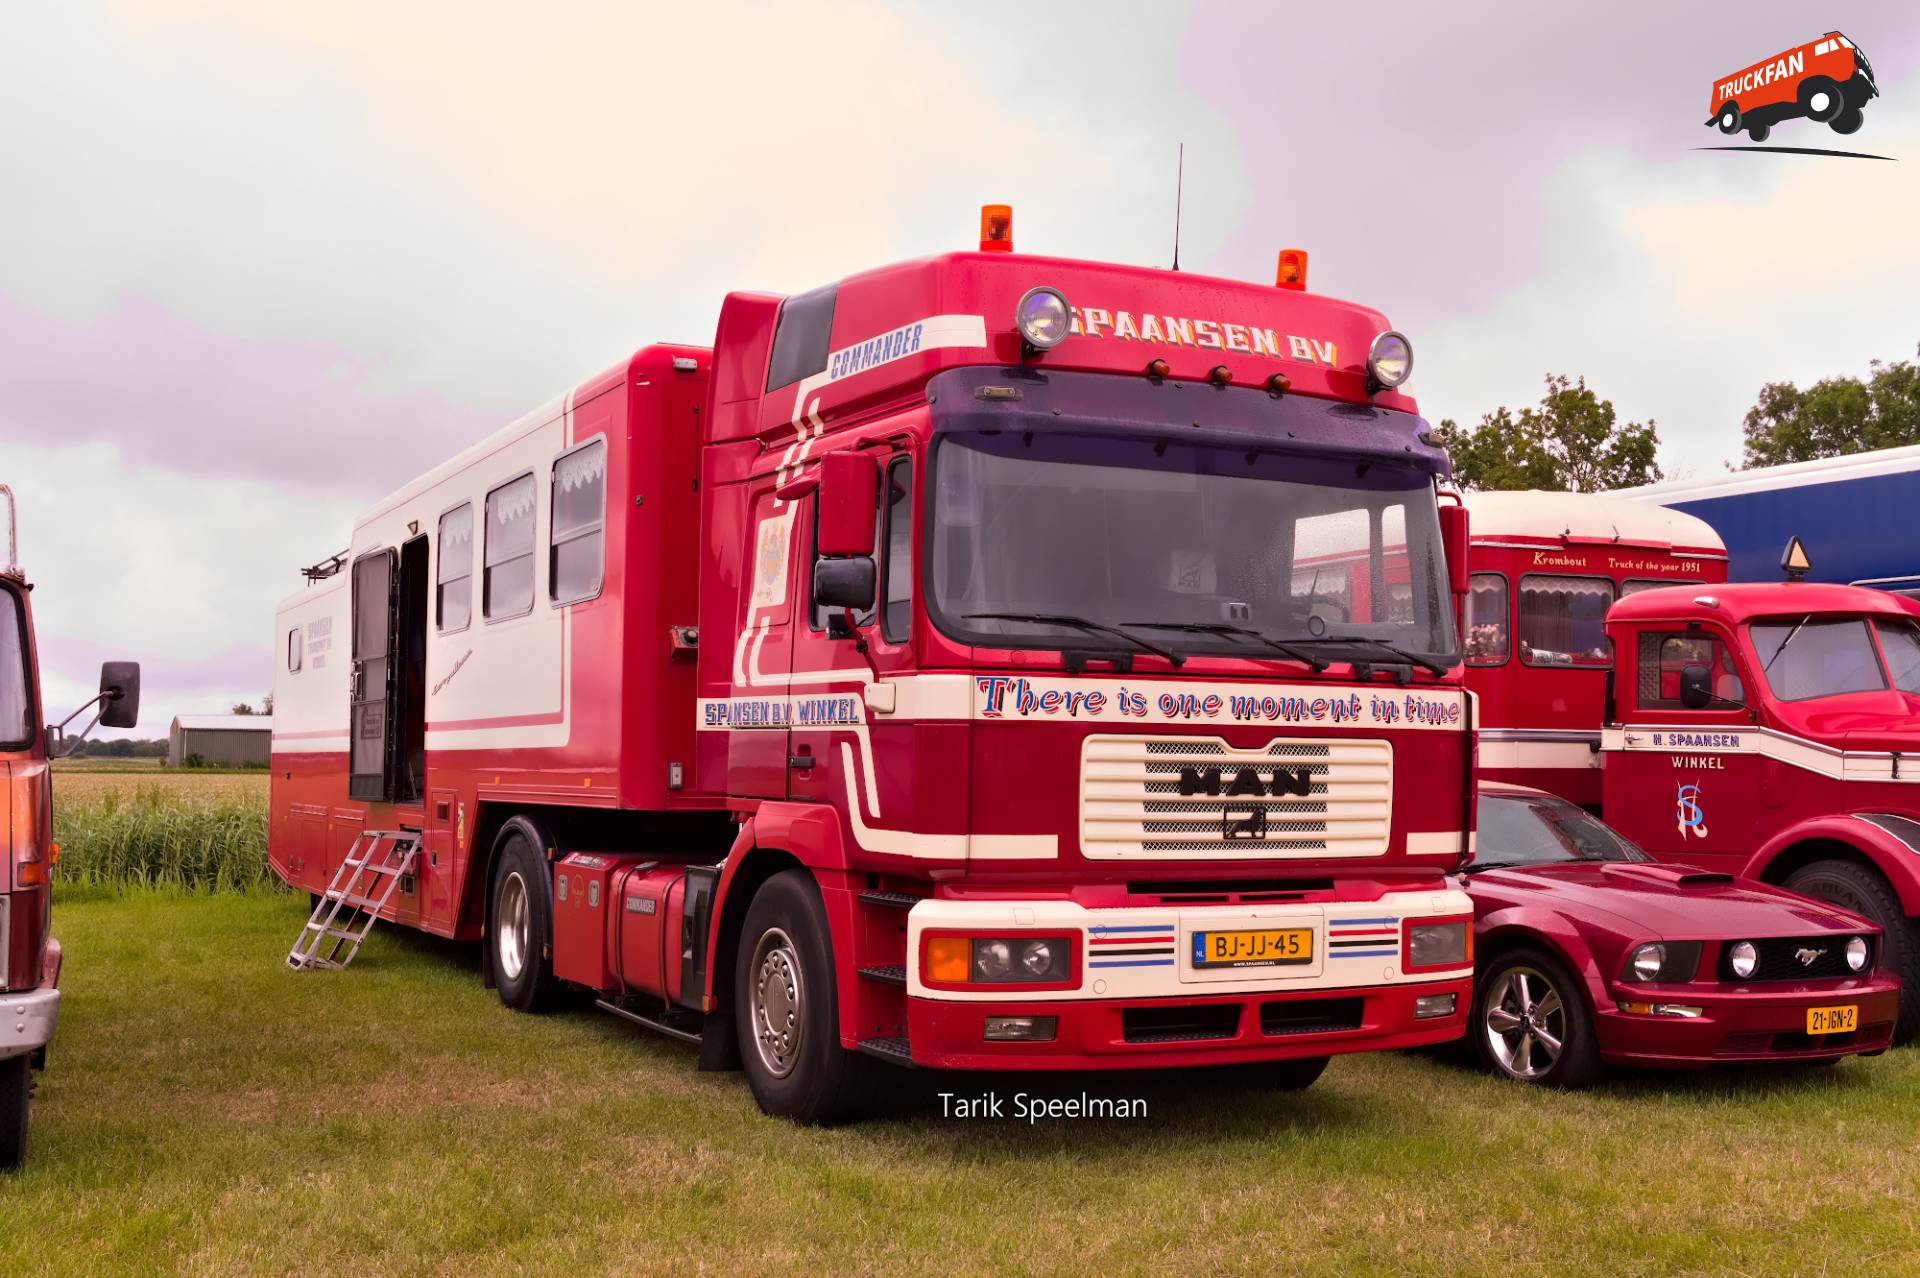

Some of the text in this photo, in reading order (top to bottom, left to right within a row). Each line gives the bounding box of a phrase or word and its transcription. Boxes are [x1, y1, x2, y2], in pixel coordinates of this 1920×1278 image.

[830, 323, 923, 380] COMMANDER
[1287, 335, 1337, 367] BV
[1608, 557, 1701, 573] Truck of the year 1951
[798, 698, 860, 724] WINKEL
[975, 676, 1461, 725] There is one moment in time
[1671, 756, 1725, 770] WINKEL
[1180, 767, 1312, 797] MAN
[1196, 934, 1300, 958] NL BJ-JJ-45
[1812, 1008, 1853, 1031] 21-JGN-2
